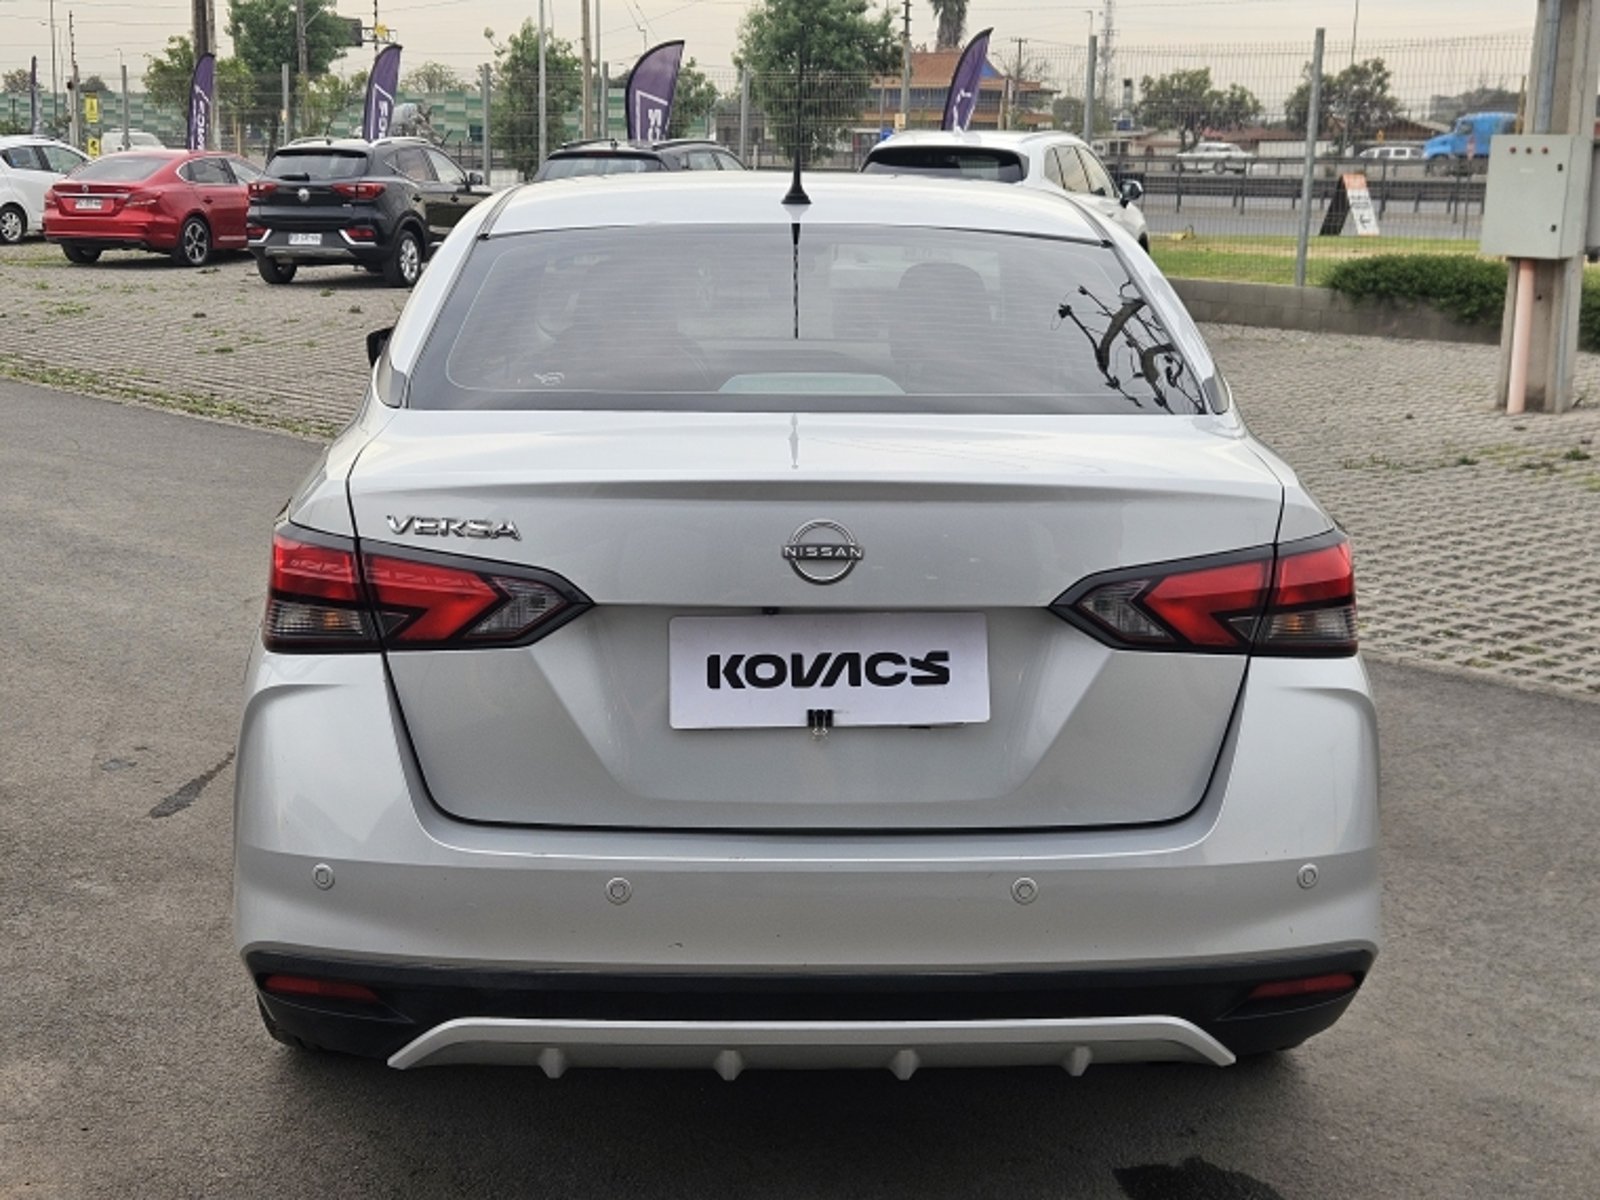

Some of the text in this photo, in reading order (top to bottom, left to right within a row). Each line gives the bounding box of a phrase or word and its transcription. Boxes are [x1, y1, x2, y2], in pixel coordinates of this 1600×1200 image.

[386, 515, 522, 541] VERSA
[784, 546, 862, 558] NISSAN
[706, 650, 951, 690] KOVACS
